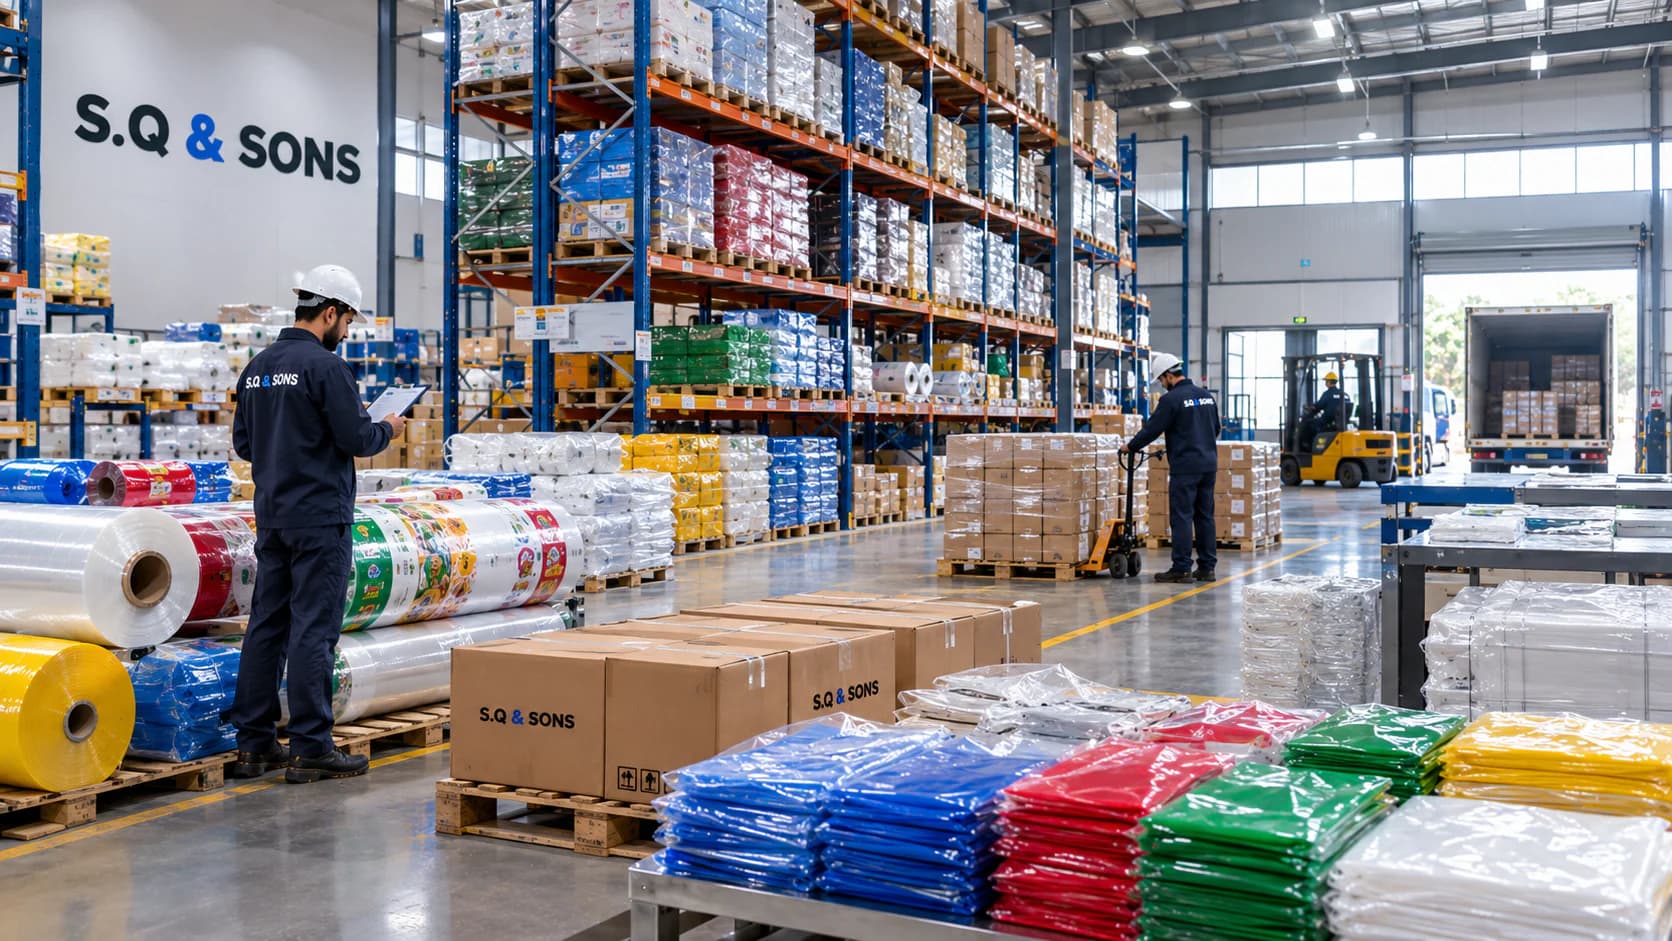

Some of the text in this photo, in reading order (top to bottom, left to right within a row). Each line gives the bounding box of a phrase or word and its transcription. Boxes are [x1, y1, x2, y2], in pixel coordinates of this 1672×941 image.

[75, 94, 361, 184] S.Q & SONS
[245, 373, 299, 389] S.Q & SONS
[813, 680, 879, 710] S.Q & SONS
[479, 707, 575, 729] S.Q & SONS
